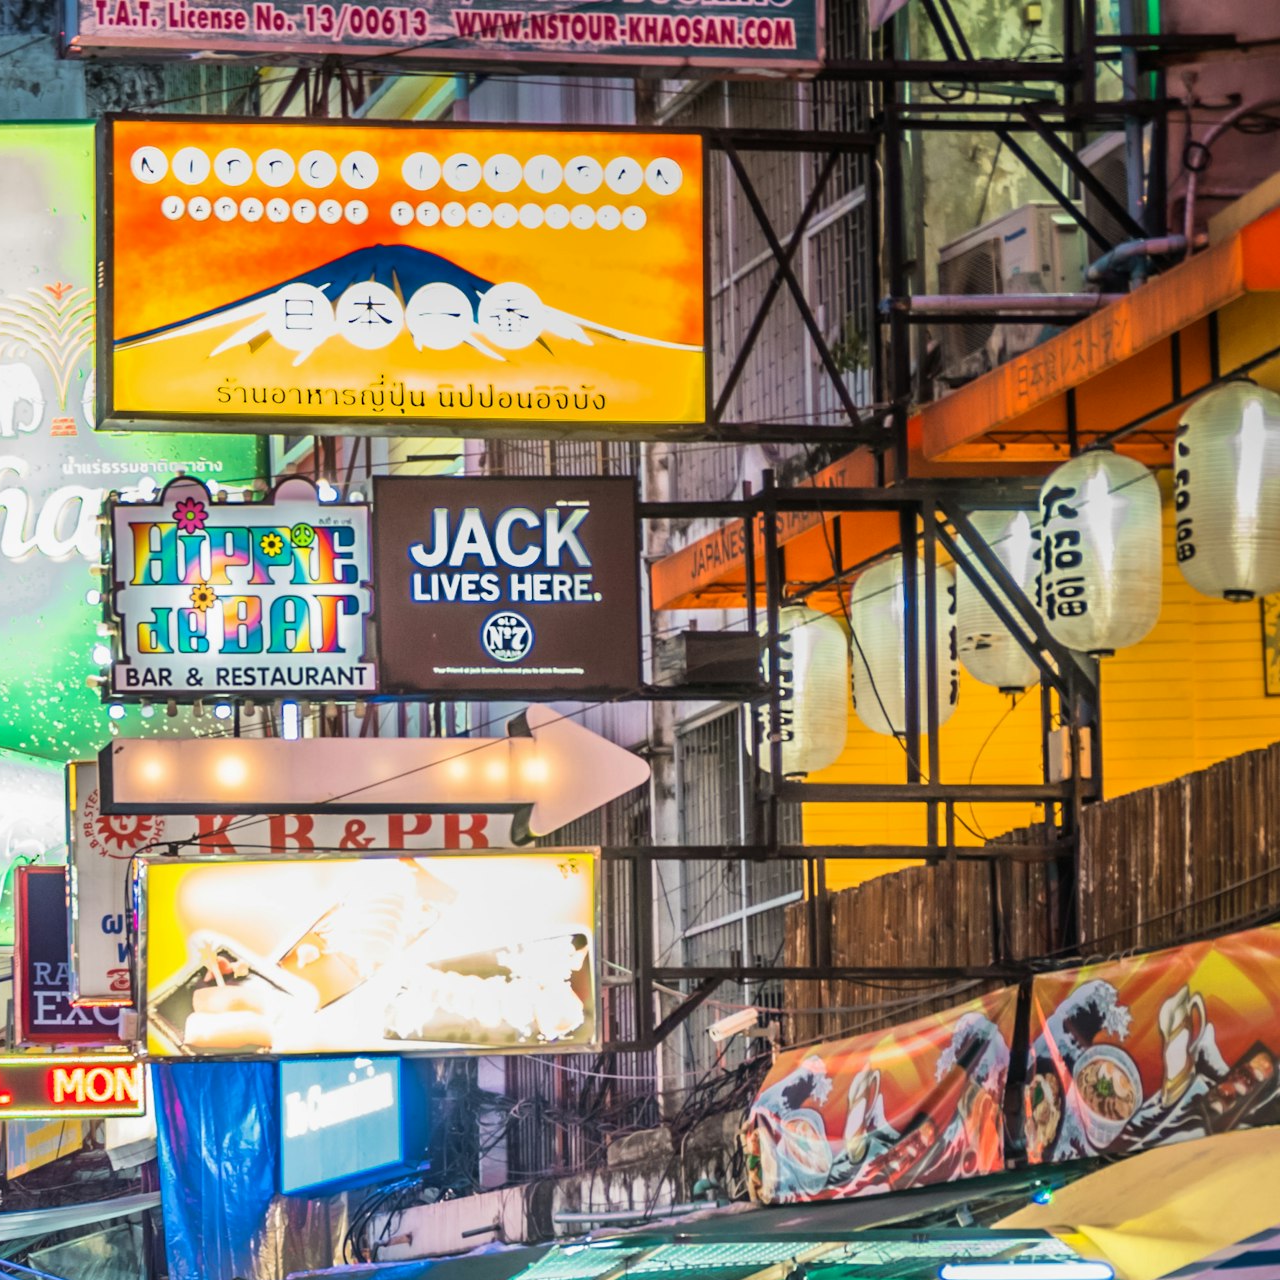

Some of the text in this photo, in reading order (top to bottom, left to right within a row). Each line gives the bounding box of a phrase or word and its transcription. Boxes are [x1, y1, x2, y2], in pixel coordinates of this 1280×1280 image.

[94, 1, 797, 48] T.A.T. License No. 13/00613 WWW.NSTOUR-KHAOSAN.COM
[410, 508, 592, 568] JACK
[691, 526, 746, 579] JAPANES
[412, 573, 602, 602] LIVES HERE.
[497, 616, 517, 626] OLD
[126, 667, 367, 687] BAR & RESTAURANT
[338, 817, 376, 850] &
[53, 1067, 142, 1104] MON
